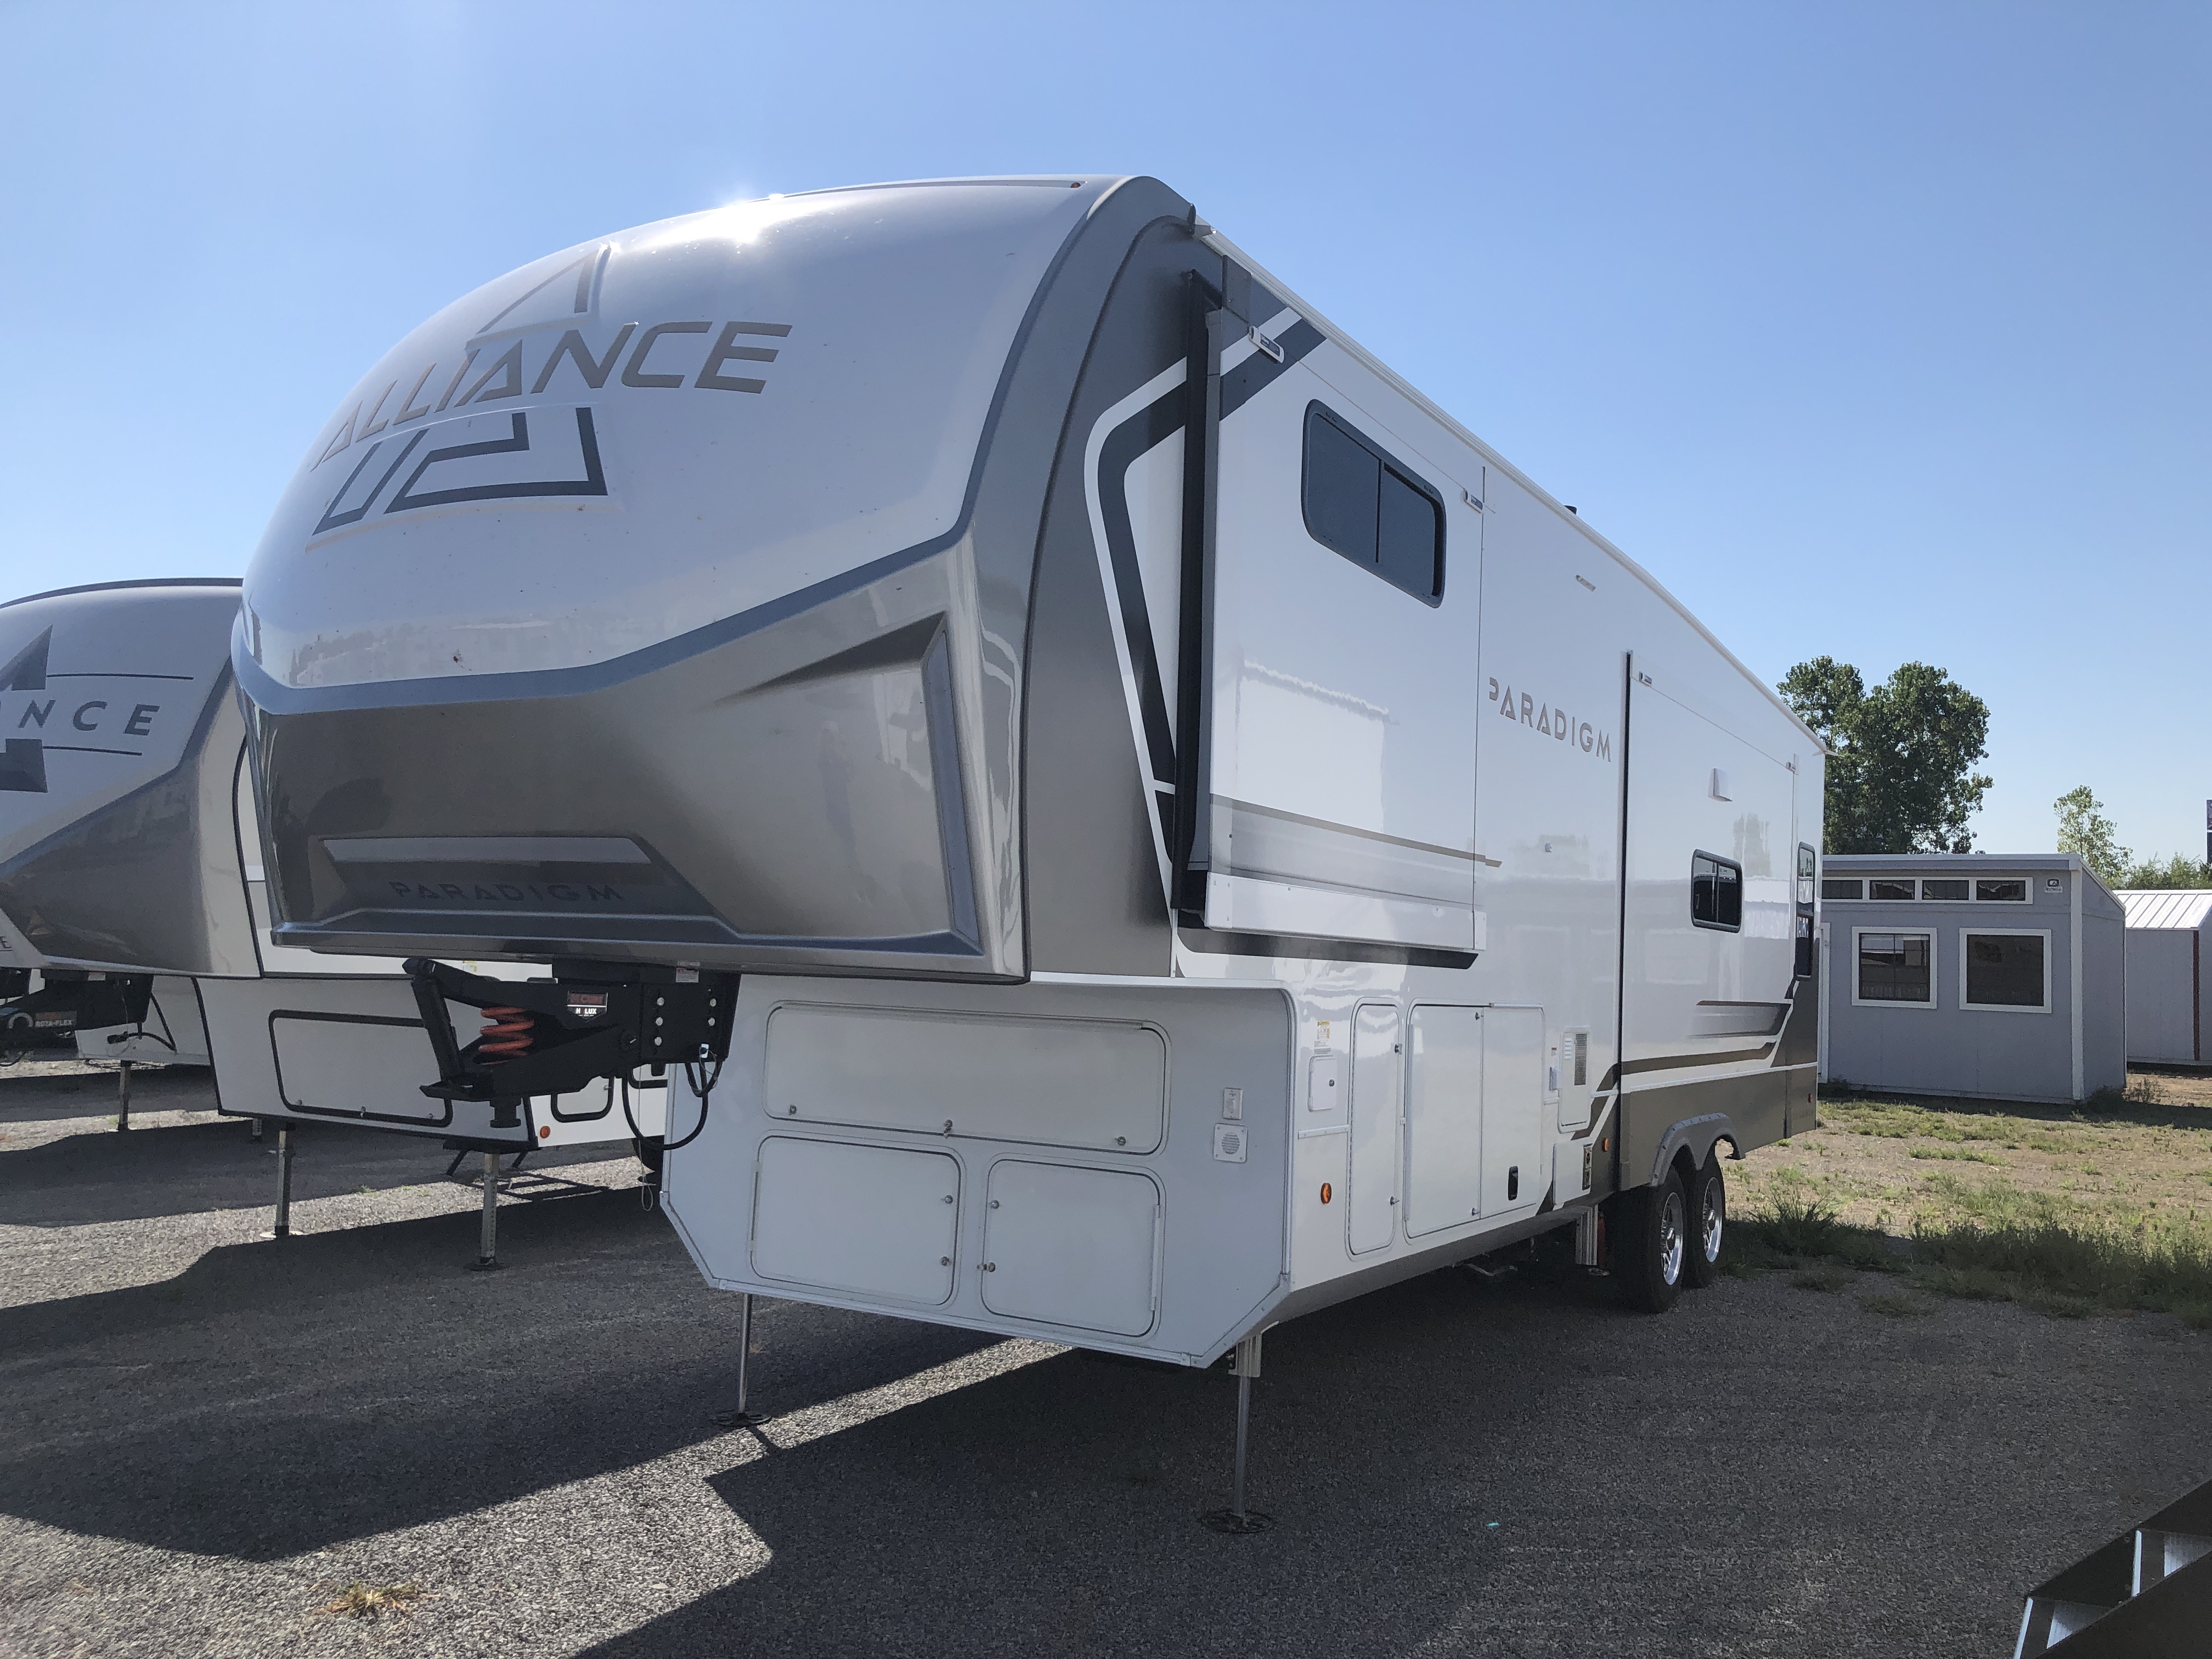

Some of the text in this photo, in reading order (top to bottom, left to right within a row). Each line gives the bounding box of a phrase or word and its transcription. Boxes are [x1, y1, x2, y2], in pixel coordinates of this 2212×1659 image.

[309, 320, 793, 472] ALLIANCE
[1488, 676, 1612, 763] PARADIGM
[387, 881, 624, 902] PARADIGM
